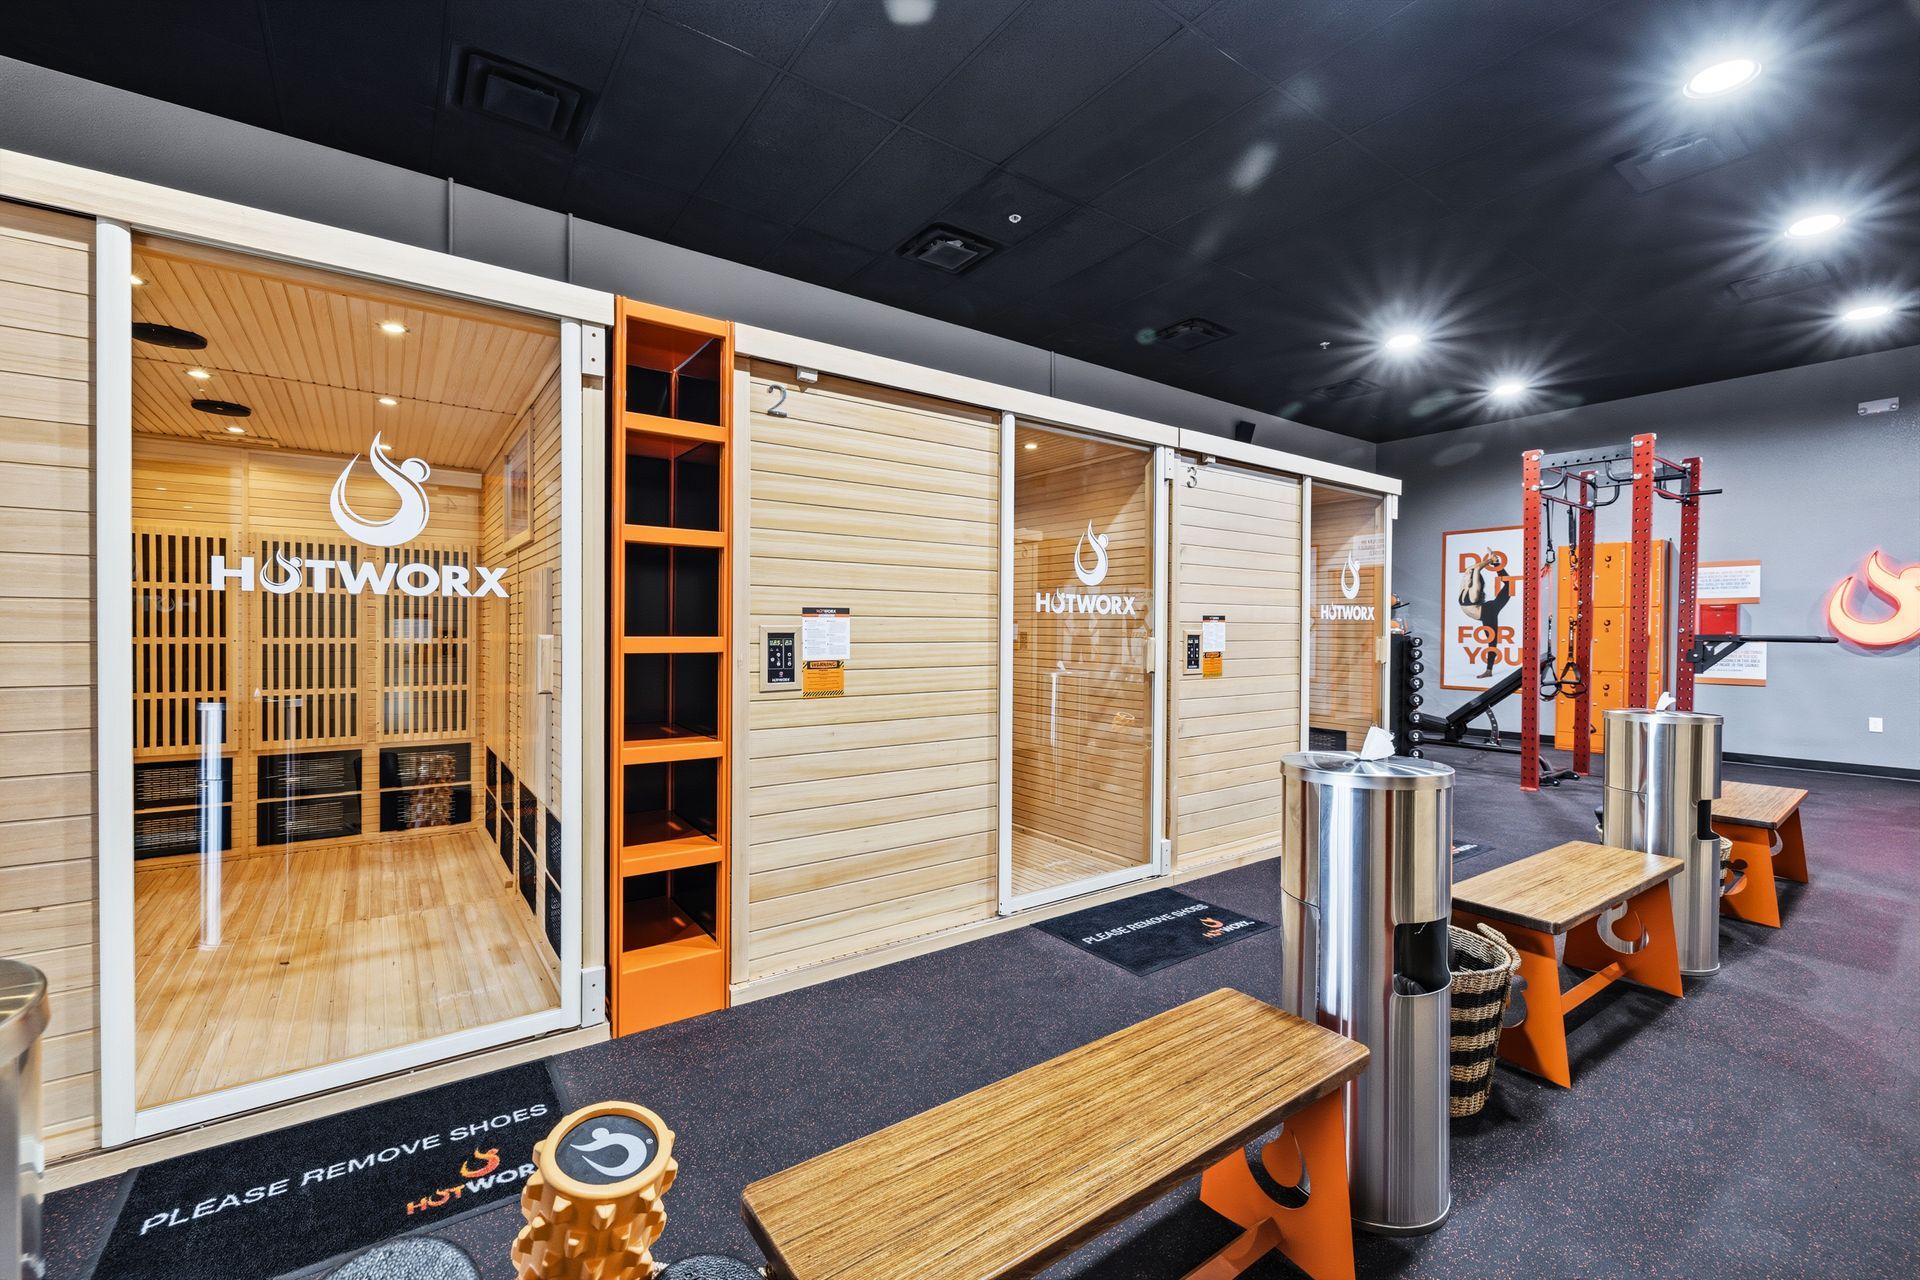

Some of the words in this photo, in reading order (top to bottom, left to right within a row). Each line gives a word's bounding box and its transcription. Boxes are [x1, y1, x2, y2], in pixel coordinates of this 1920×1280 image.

[767, 384, 787, 418] 2
[1186, 466, 1198, 489] 3
[211, 547, 510, 598] HOTWORX
[1458, 550, 1508, 573] DO
[1494, 575, 1524, 597] IT
[1035, 587, 1136, 616] HOTWORX
[1320, 601, 1375, 621] HOTWORX
[1457, 625, 1516, 645] FOR
[1463, 646, 1524, 667] YOU
[1082, 926, 1131, 945] PLEASE
[1126, 913, 1176, 931] REMOVE
[1171, 903, 1209, 917] SHOES
[140, 1179, 289, 1236] PLEASE
[302, 1133, 441, 1187] REMOVE
[448, 1103, 548, 1142] SHOES
[406, 1163, 536, 1216] HOTWOR
